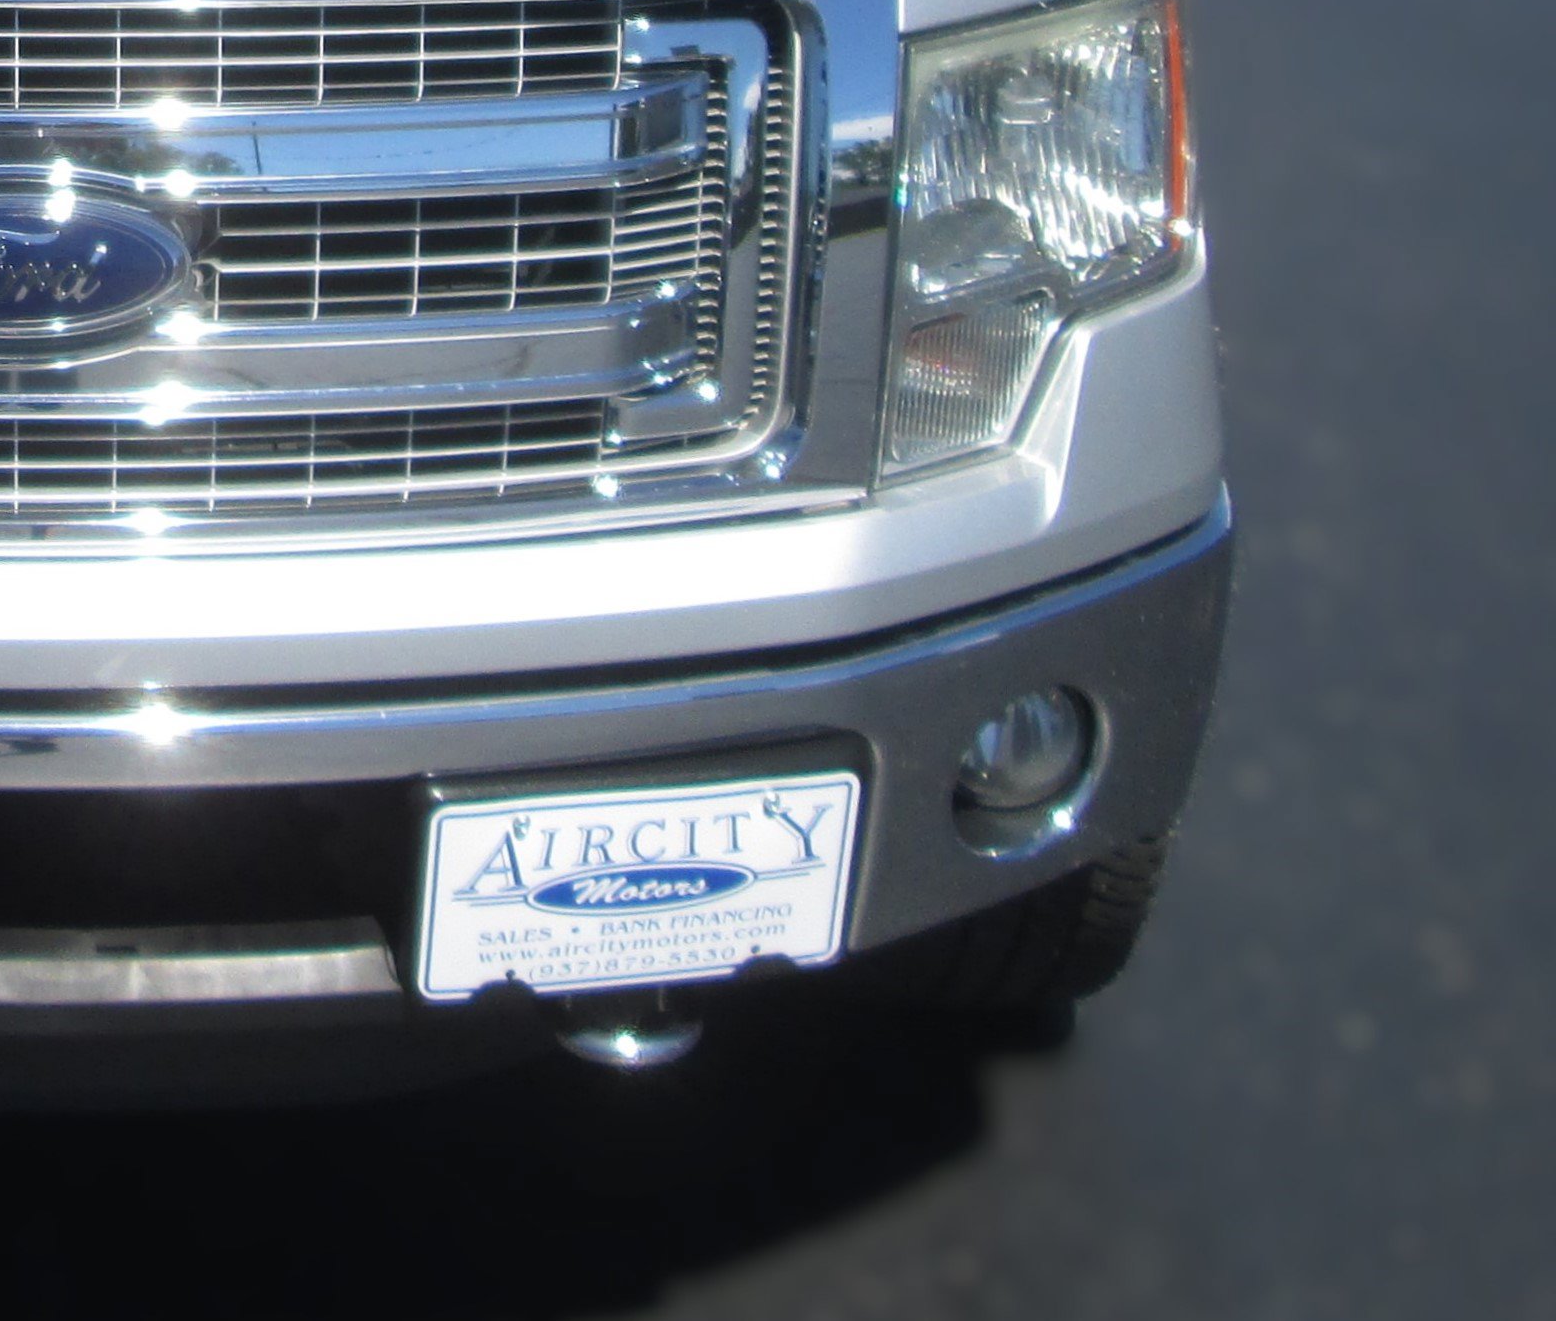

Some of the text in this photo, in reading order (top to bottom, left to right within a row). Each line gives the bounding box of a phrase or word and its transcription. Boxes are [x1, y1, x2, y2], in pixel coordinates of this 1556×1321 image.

[573, 877, 710, 905] Motors
[478, 927, 552, 946] SALES
[600, 917, 661, 936] BANK
[479, 923, 786, 963] www.aircitymotors.com
